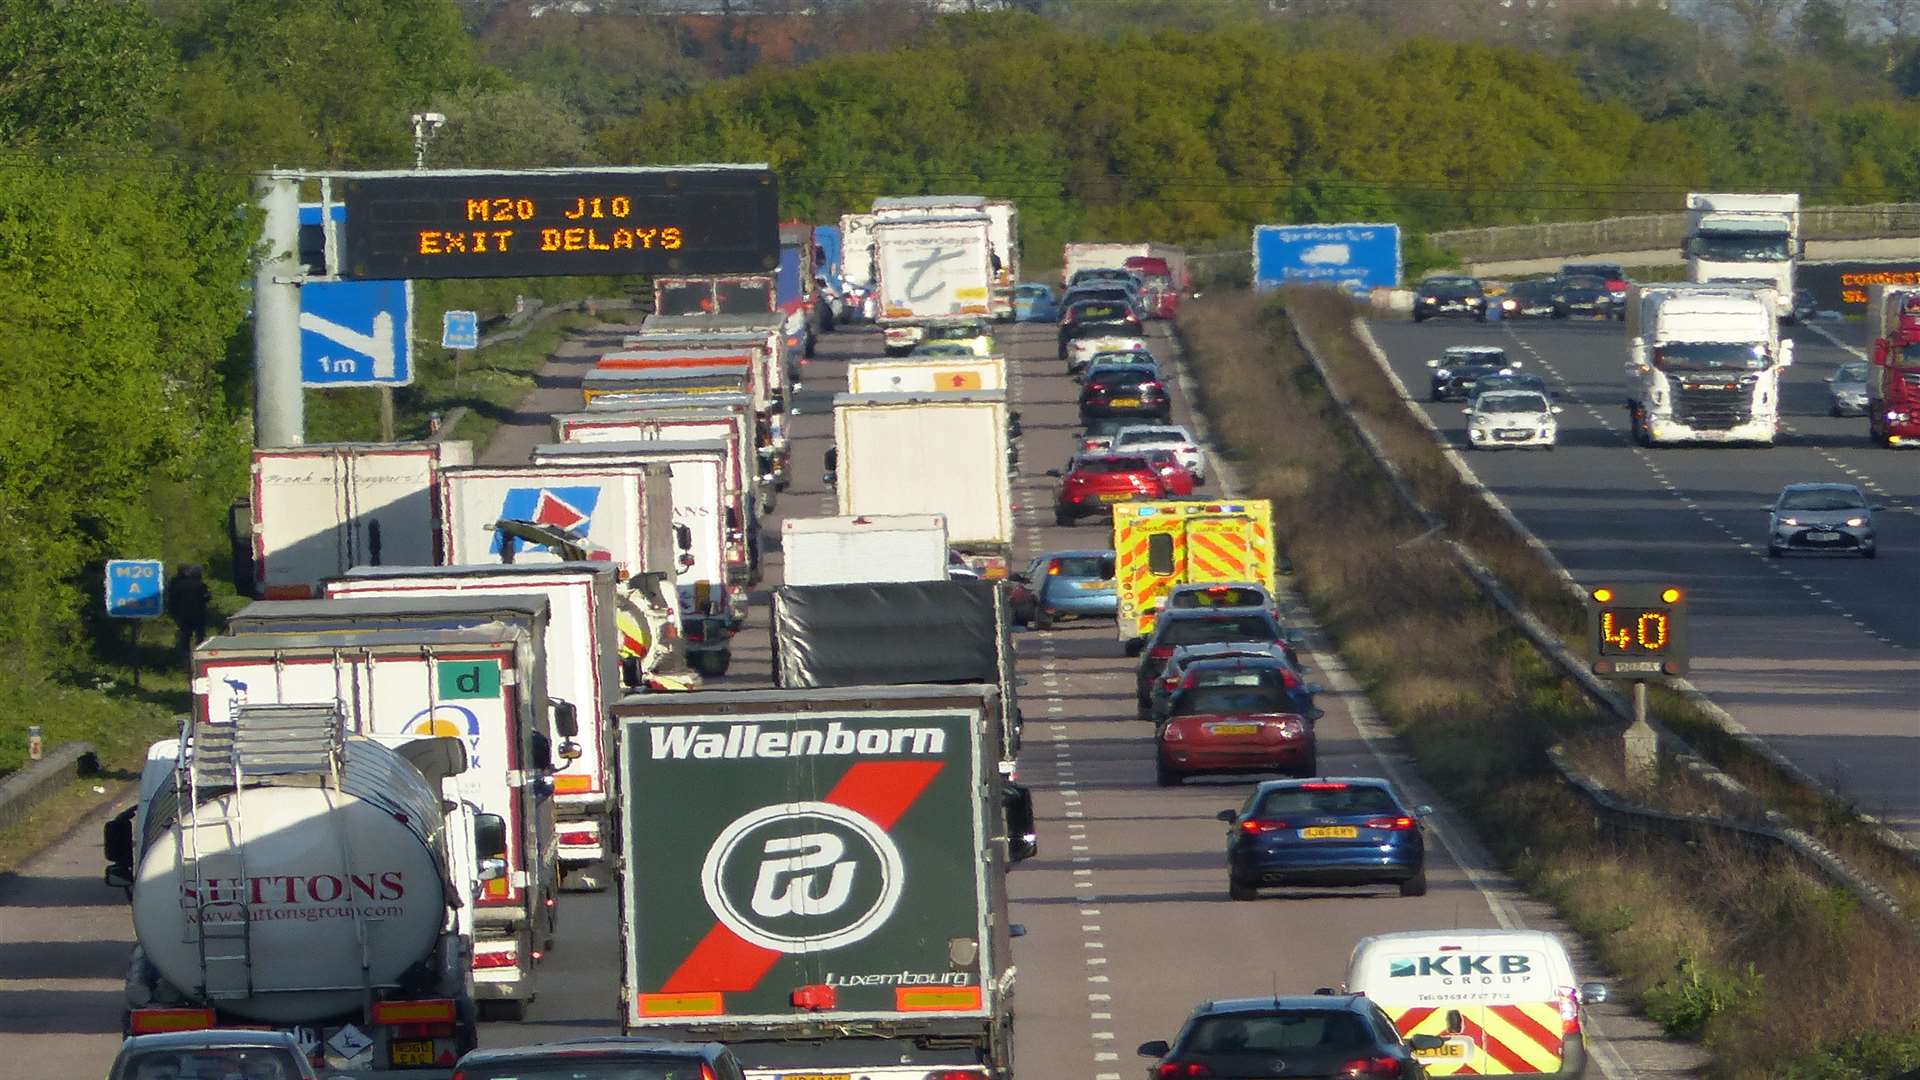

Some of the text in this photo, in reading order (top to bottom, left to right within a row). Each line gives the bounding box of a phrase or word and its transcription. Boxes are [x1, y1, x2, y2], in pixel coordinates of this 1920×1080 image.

[466, 197, 631, 221] M20 J10
[419, 227, 684, 254] EXIT DELAYS
[317, 356, 356, 373] 1m
[116, 566, 153, 578] M20
[129, 582, 141, 593] A
[1602, 612, 1667, 650] 40
[456, 666, 481, 693] d
[649, 722, 945, 760] Wallenborn
[180, 872, 404, 908] SUTTONS
[1418, 954, 1531, 976] KKB
[825, 970, 969, 988] Luxembourg
[1442, 975, 1531, 986] GROUP
